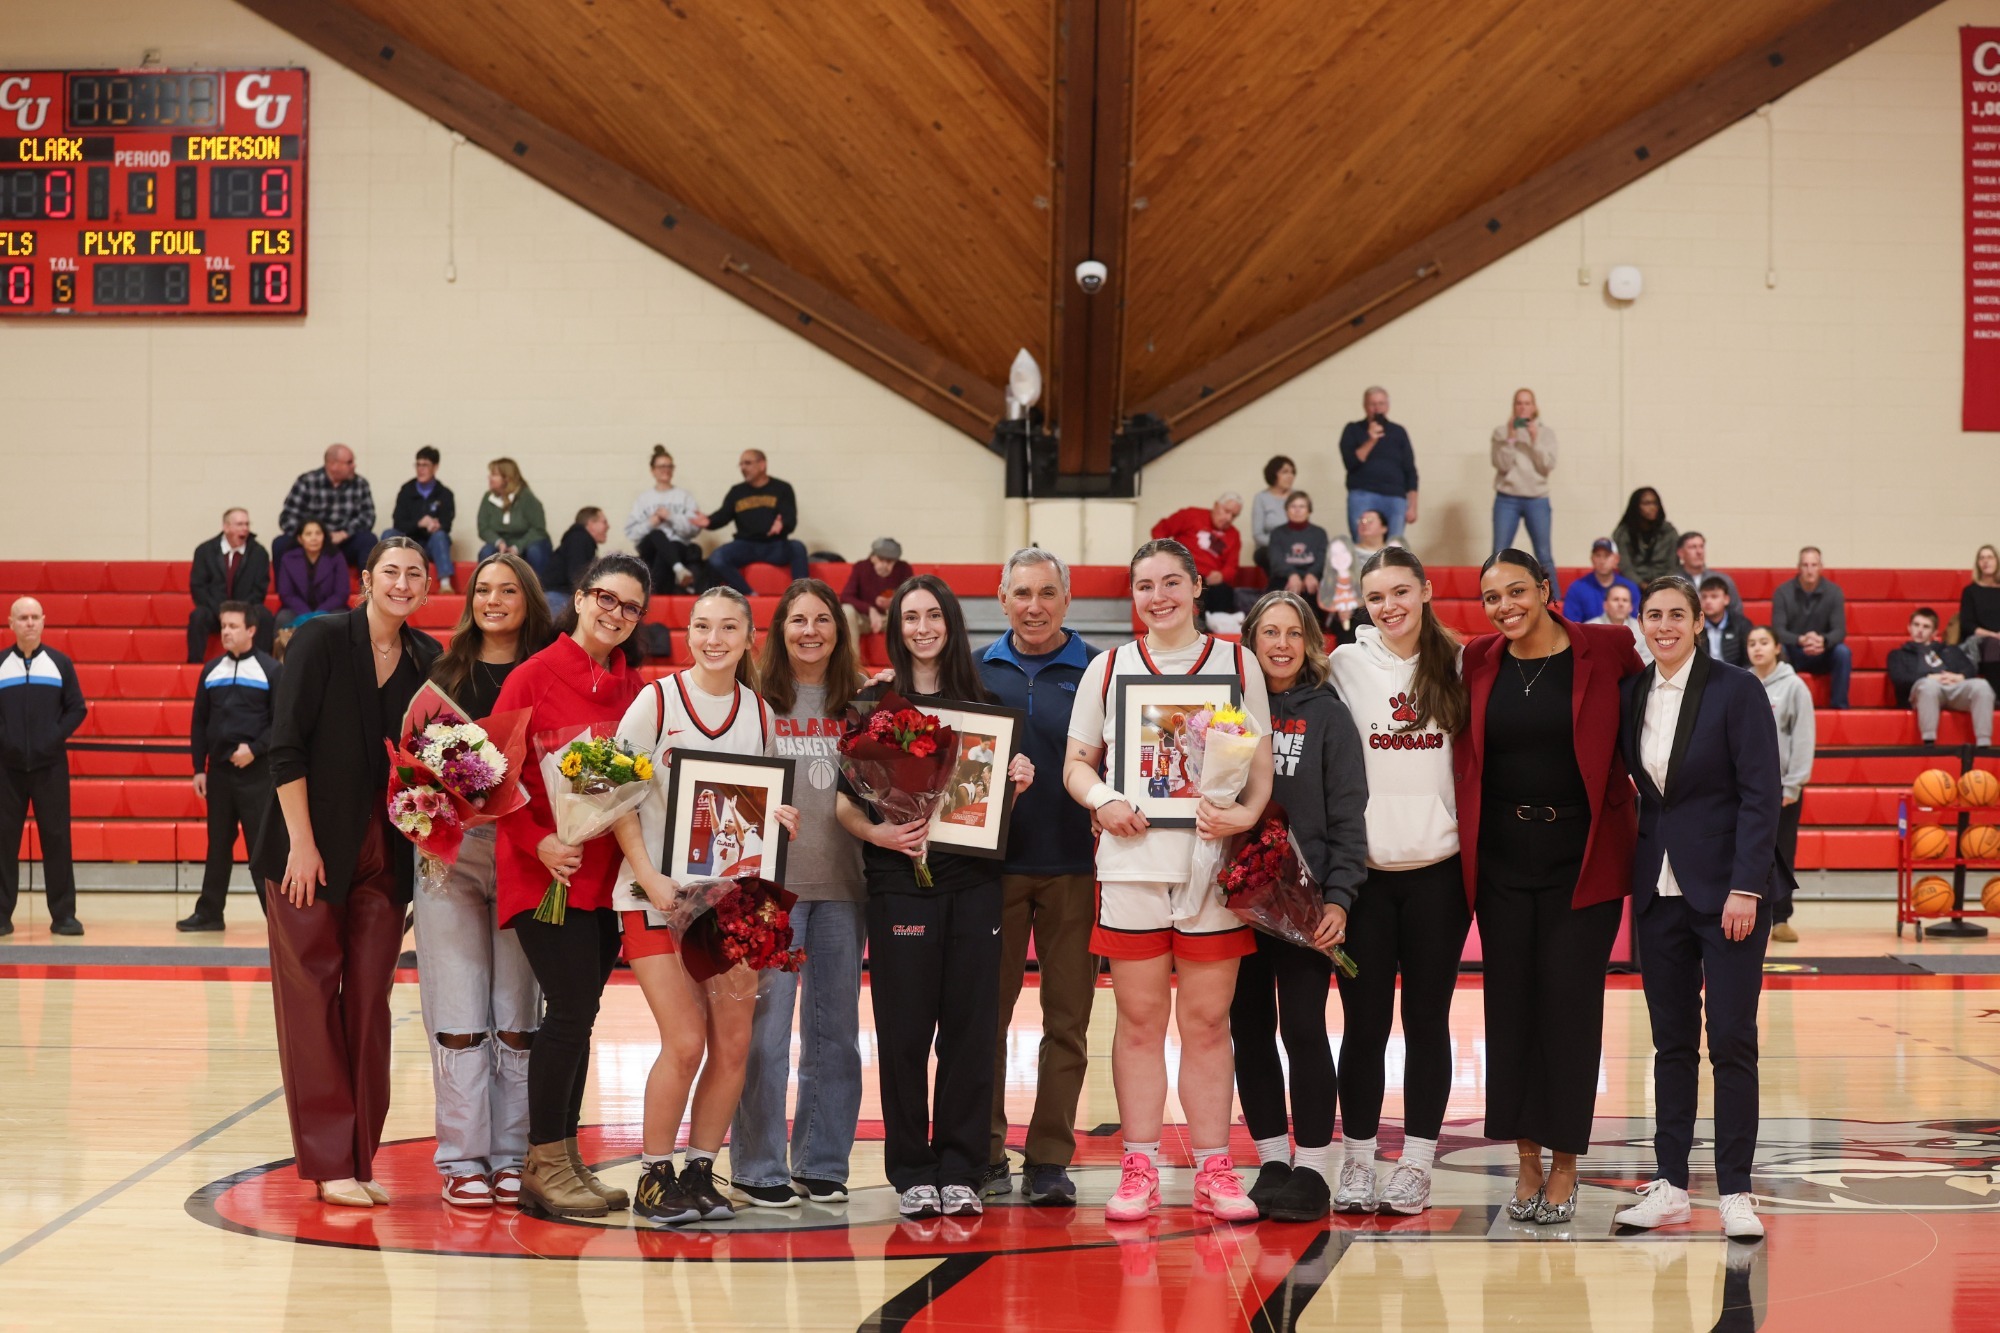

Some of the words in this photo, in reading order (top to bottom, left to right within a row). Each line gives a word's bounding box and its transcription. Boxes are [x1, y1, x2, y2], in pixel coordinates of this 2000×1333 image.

[1972, 81, 2000, 93] WO
[19, 137, 83, 161] CLARK
[115, 150, 170, 167] PERIOD
[188, 136, 281, 160] EMERSON
[45, 170, 71, 218] 0
[146, 178, 154, 209] 1
[261, 169, 288, 217] 0
[84, 231, 136, 255] PLYR
[150, 230, 202, 255] FOUL
[251, 230, 290, 254] FLS
[9, 266, 30, 304] 0
[56, 275, 72, 302] 5
[211, 274, 228, 301] 5
[265, 264, 288, 303] 0
[1369, 733, 1443, 750] COUGARS
